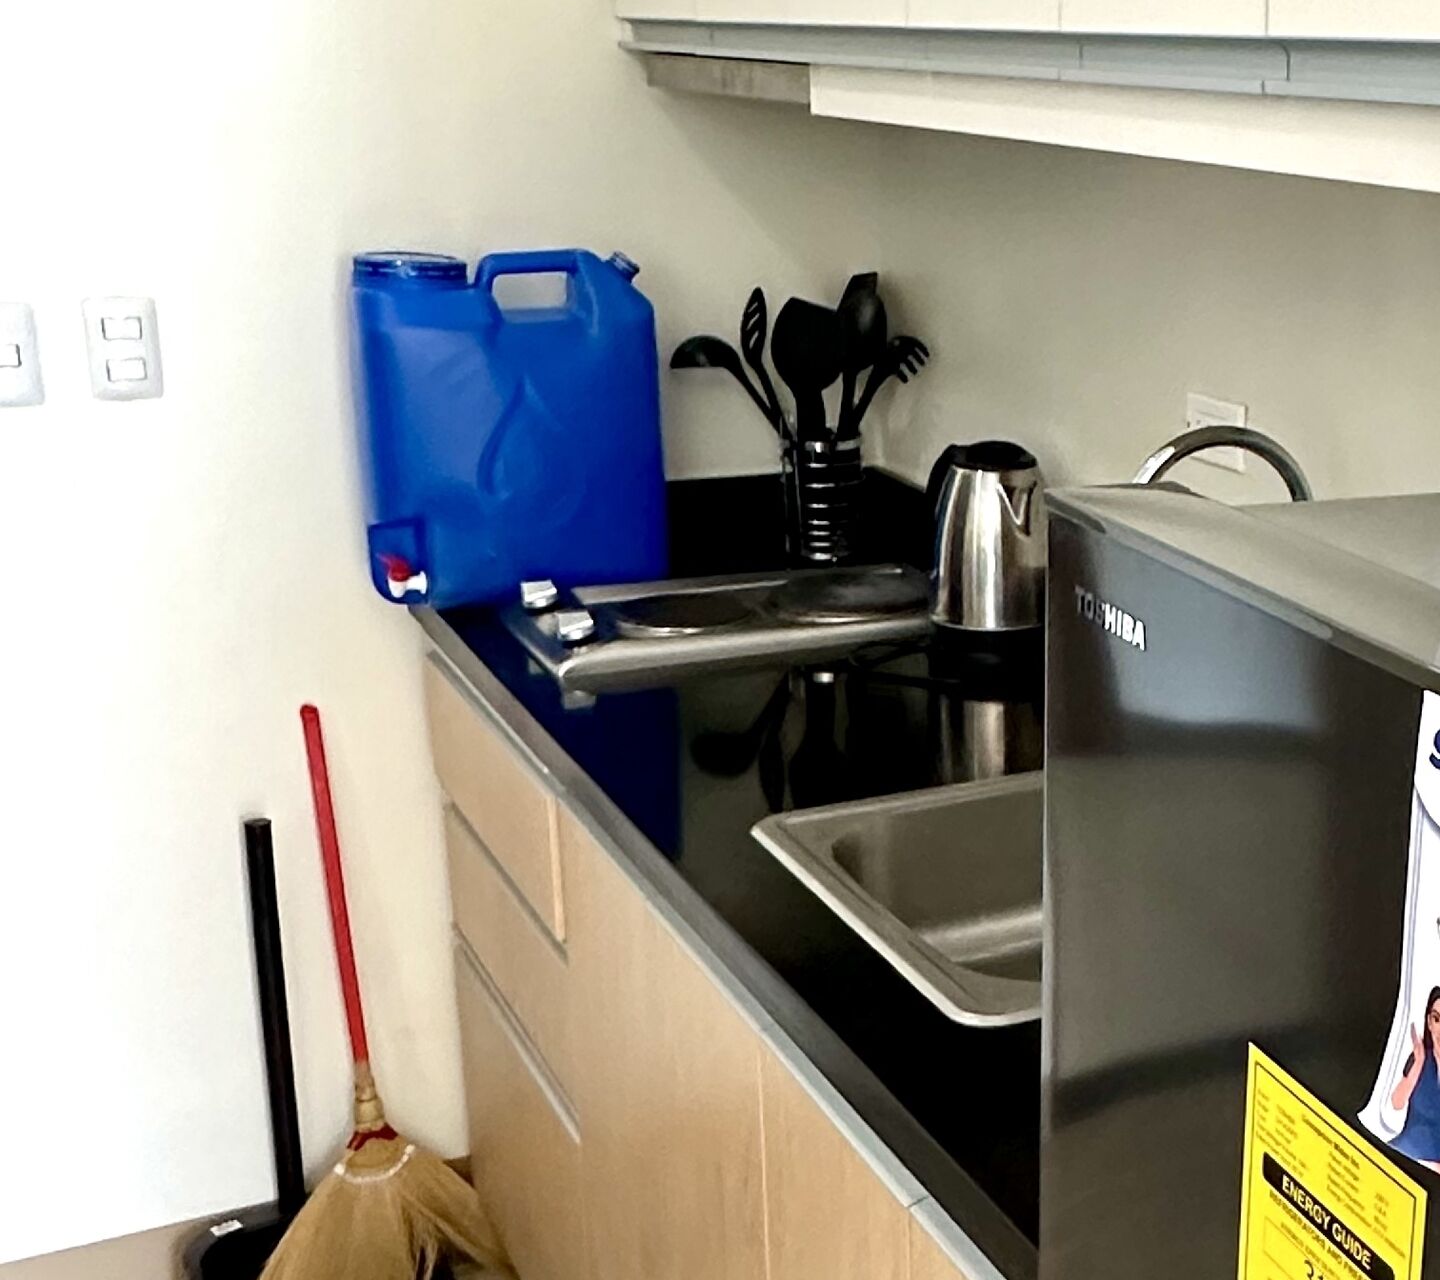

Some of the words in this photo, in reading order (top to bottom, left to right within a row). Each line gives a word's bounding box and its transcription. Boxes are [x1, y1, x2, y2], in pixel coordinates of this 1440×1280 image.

[1074, 584, 1146, 651] TOSHIBA
[1281, 1174, 1331, 1231] ENERGY
[1331, 1221, 1372, 1271] GUIDE
